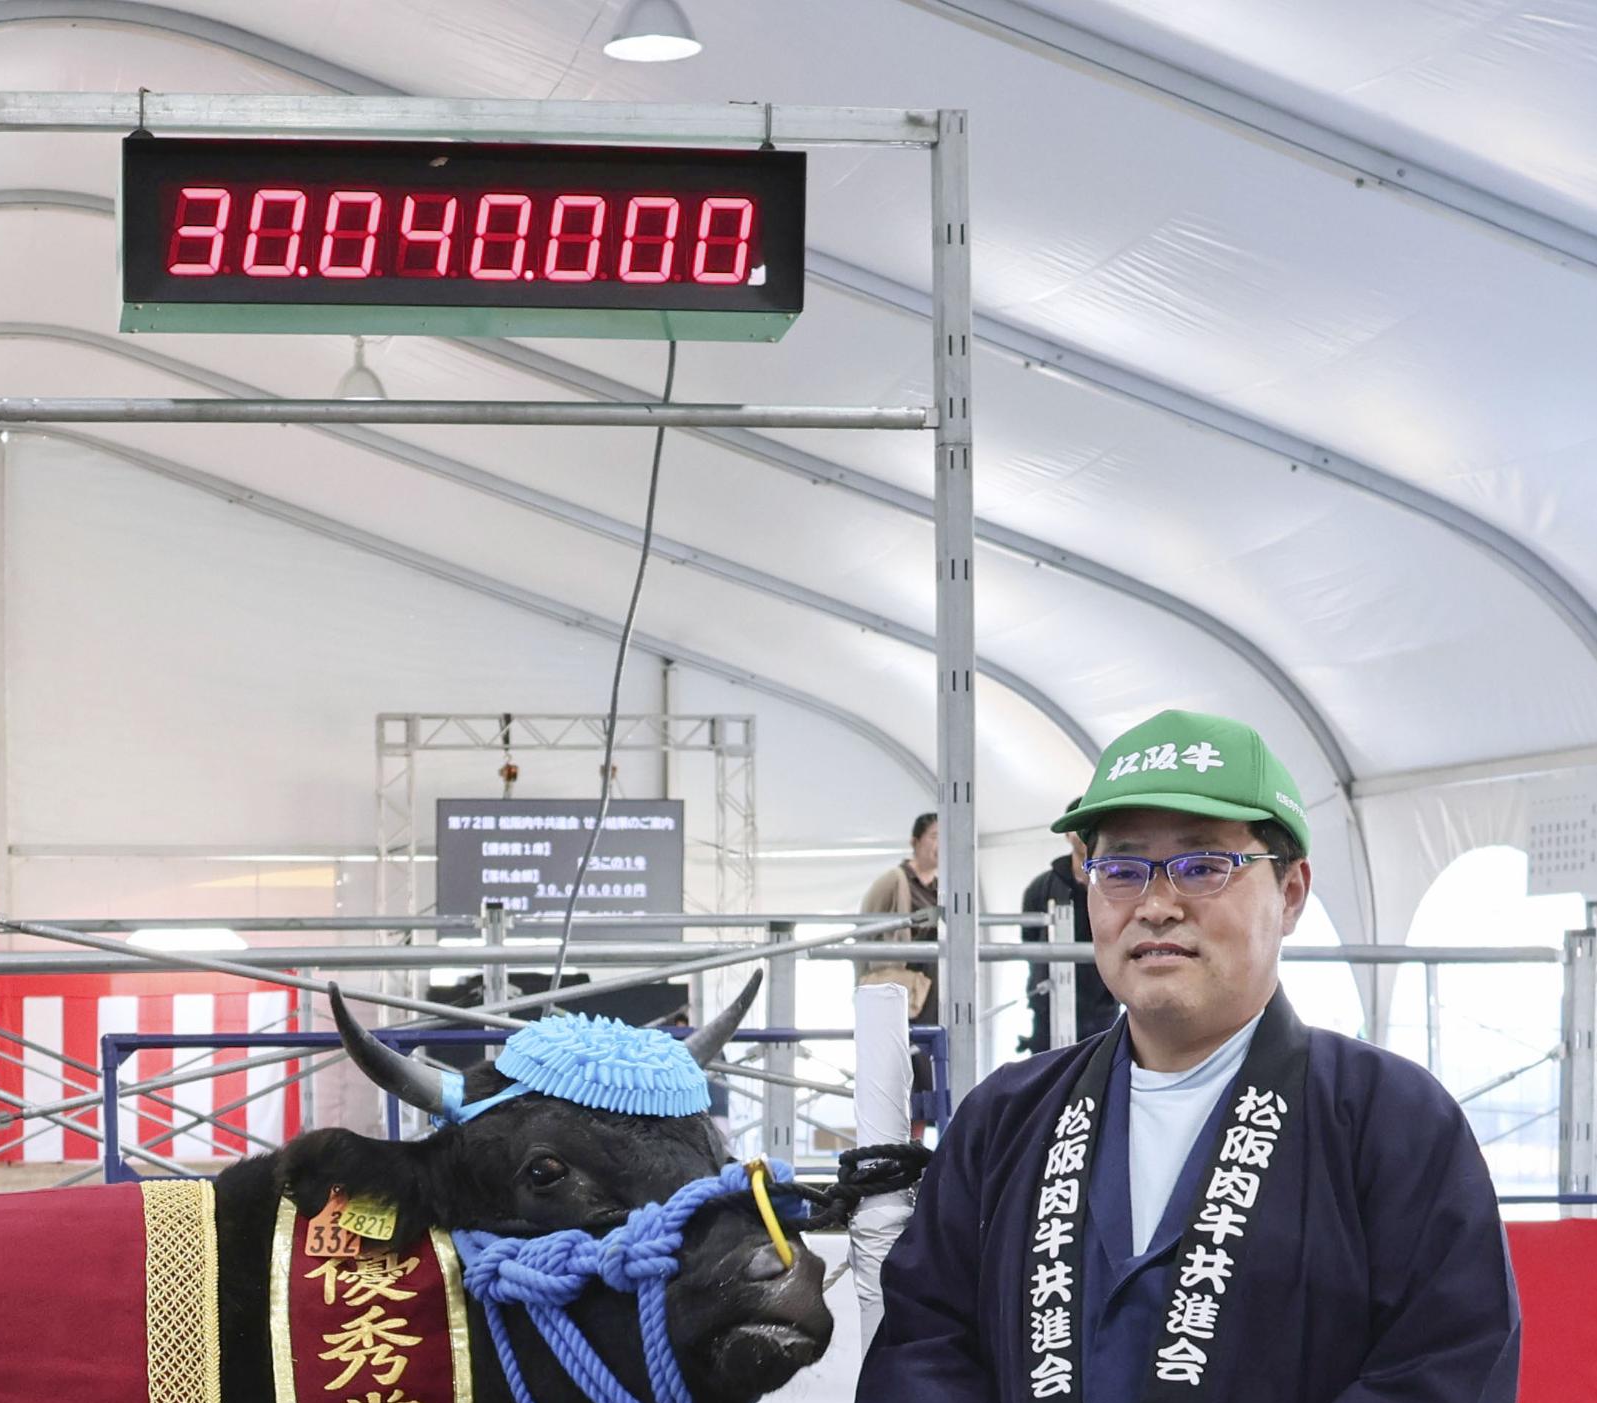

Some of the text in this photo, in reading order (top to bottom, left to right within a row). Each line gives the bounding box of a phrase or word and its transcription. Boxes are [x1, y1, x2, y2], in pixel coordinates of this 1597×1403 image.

[168, 186, 754, 284] 30.040.000
[1106, 741, 1225, 782] 松阪牛
[1030, 1096, 1095, 1399] 松阪肉牛共進会
[1155, 1085, 1289, 1386] 松阪肉牛共進会
